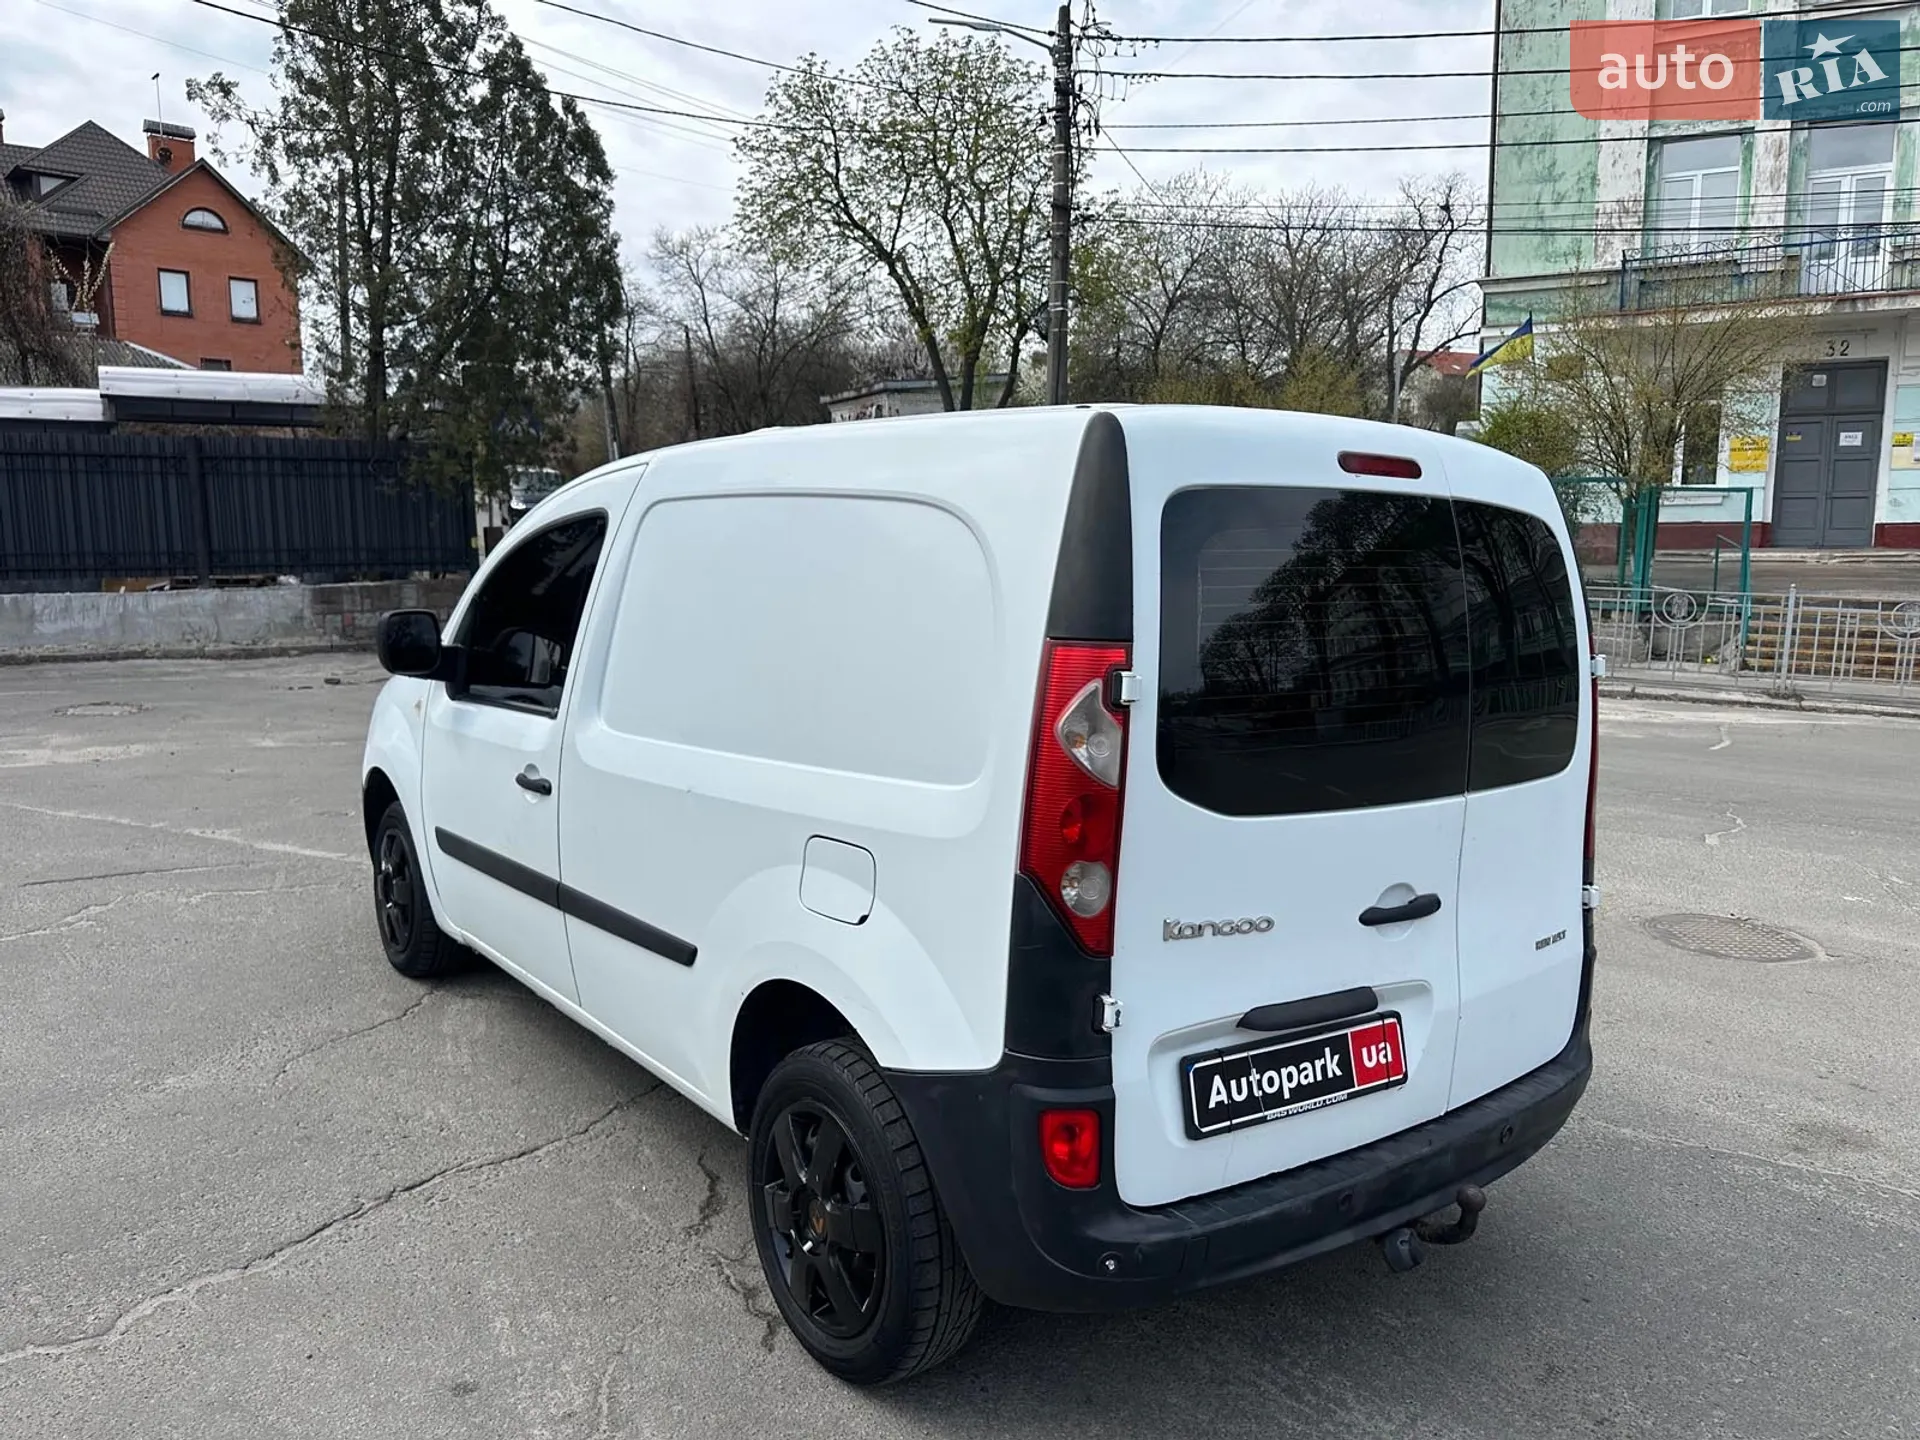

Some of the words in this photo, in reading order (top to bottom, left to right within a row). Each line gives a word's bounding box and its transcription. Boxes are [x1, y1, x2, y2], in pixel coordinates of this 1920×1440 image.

[1826, 339, 1850, 357] 32
[1162, 915, 1275, 942] Kangoo
[1208, 1047, 1342, 1110] Autopark
[1361, 1038, 1393, 1069] ua
